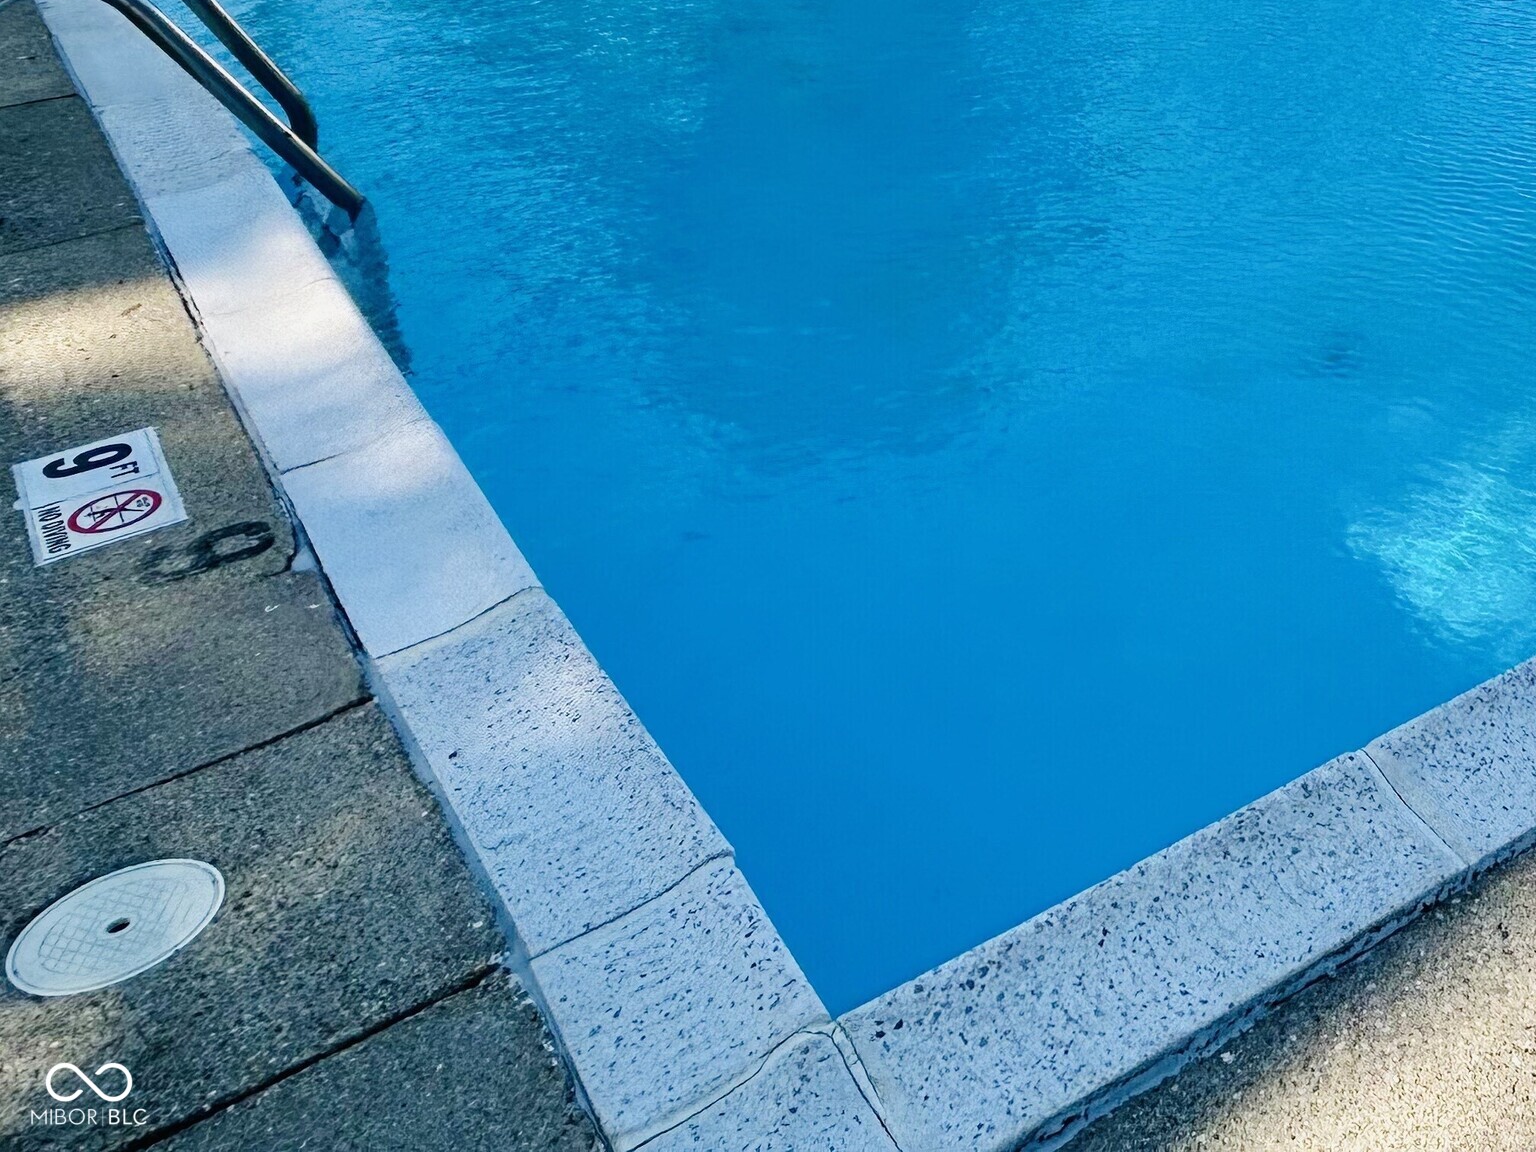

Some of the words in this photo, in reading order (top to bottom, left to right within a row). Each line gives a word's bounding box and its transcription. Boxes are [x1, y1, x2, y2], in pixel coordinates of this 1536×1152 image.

[42, 443, 132, 479] 9
[108, 460, 140, 479] FT
[38, 505, 61, 523] NO
[40, 520, 72, 554] DIVING
